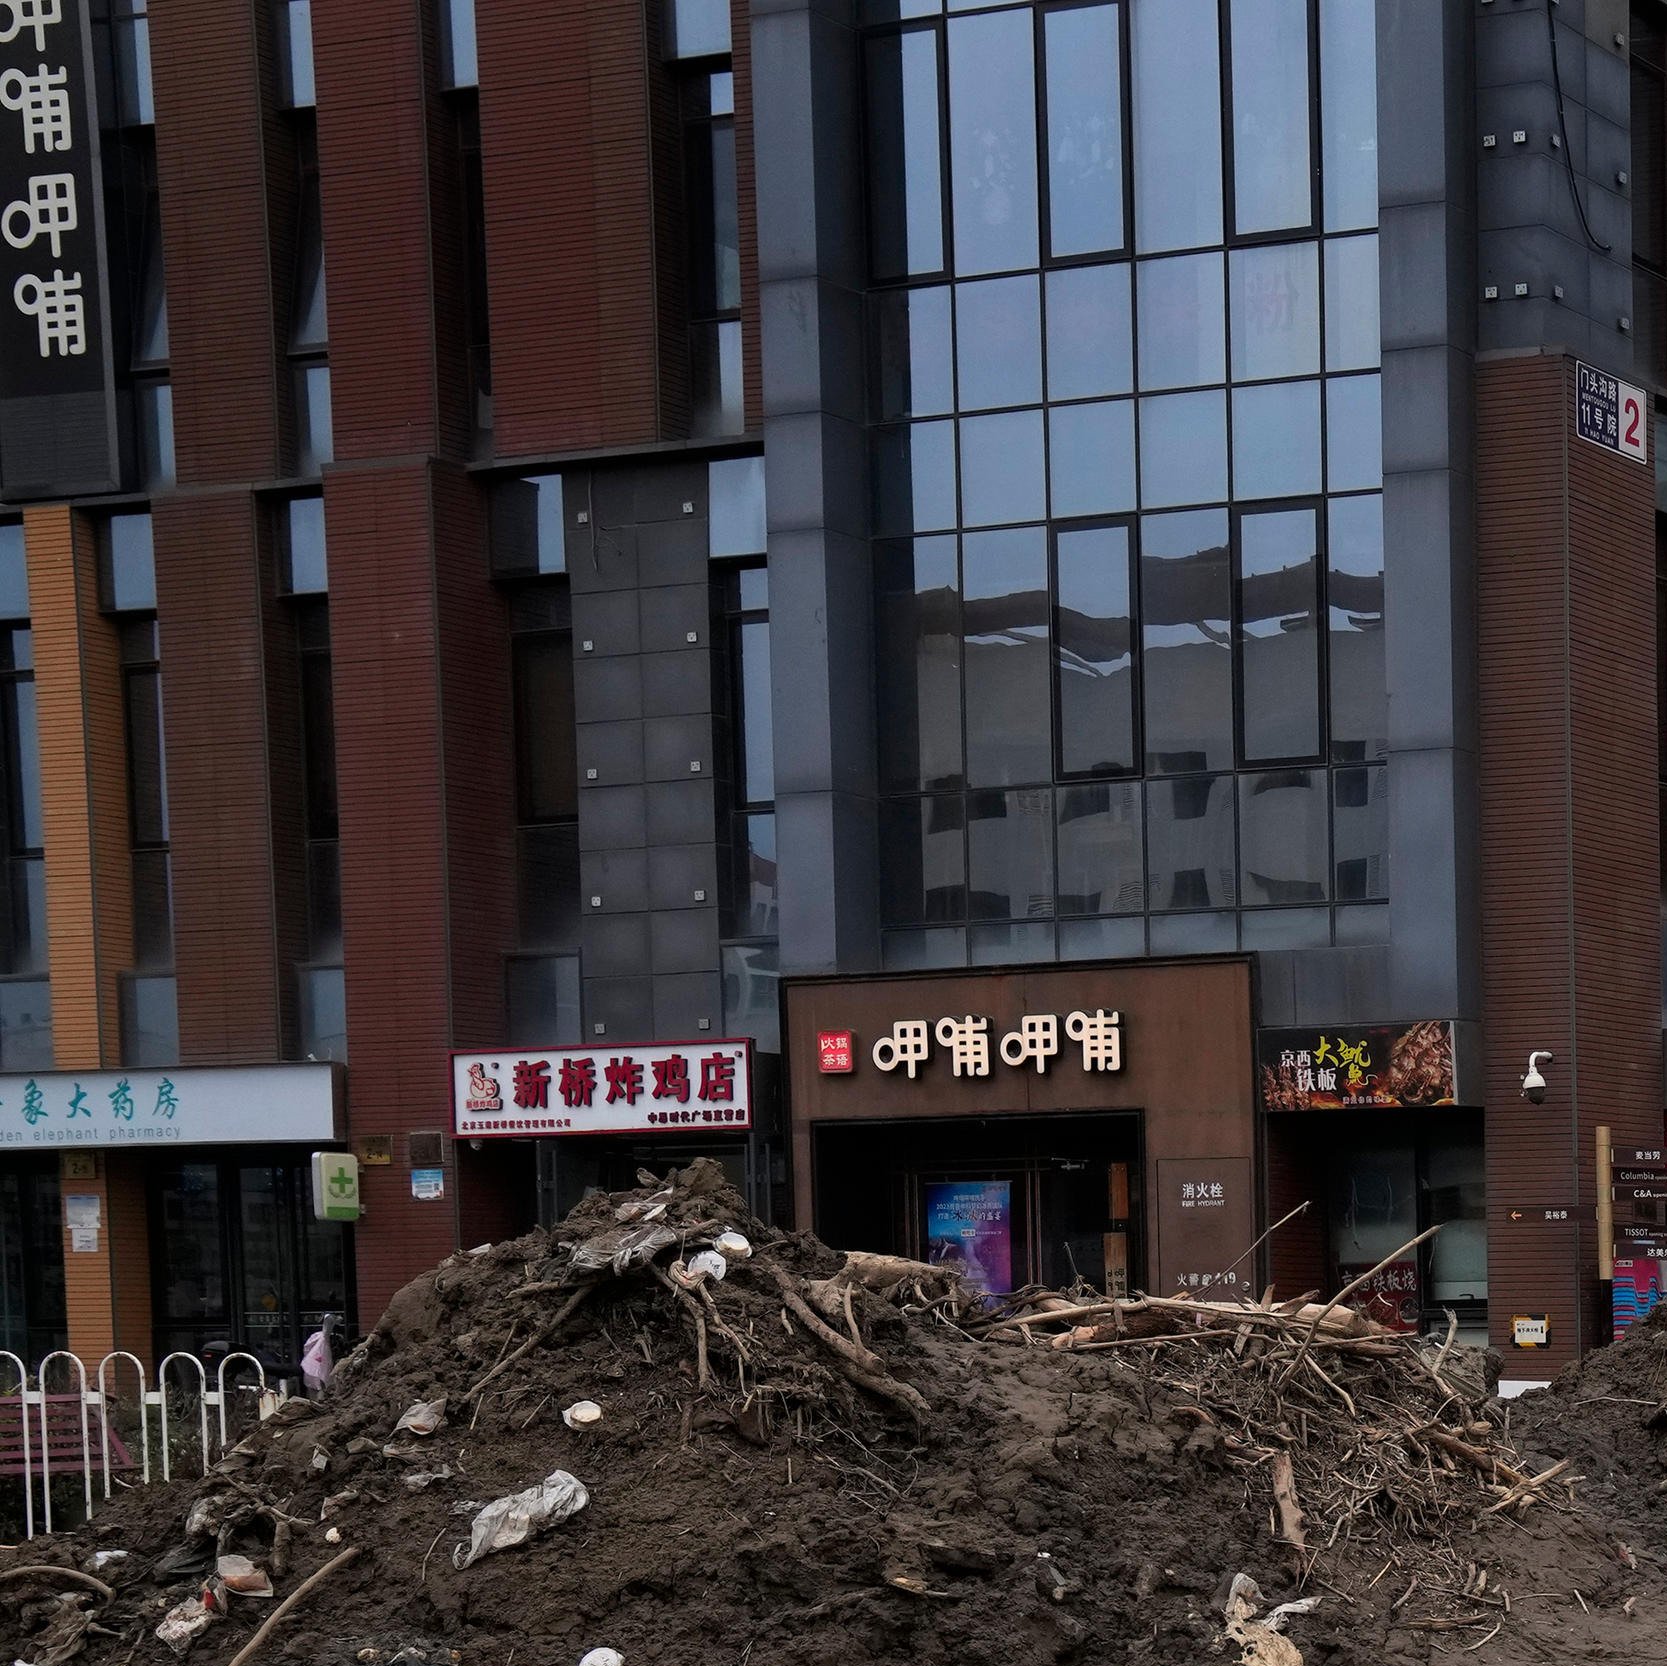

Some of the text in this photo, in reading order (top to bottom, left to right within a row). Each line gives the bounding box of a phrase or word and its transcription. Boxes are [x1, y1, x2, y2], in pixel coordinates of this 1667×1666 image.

[1580, 367, 1617, 402] 门头沟路
[1582, 391, 1609, 410] MENTOUGOU
[1581, 402, 1617, 437] 11号院
[1624, 398, 1640, 448] 2
[872, 1009, 1122, 1079] 呷哺呷哺
[1279, 1050, 1311, 1068] 京西
[512, 1052, 736, 1109] 新桥炸鸡店
[1295, 1067, 1337, 1092] 铁板
[0, 1077, 180, 1126] 象大药房
[33, 1127, 99, 1144] elephant
[109, 1126, 181, 1143] pharmacy
[1635, 1150, 1662, 1161] 麦当劳
[1619, 1171, 1655, 1181] Columbia
[1182, 1182, 1224, 1199] 消火栓
[1633, 1189, 1652, 1198] C&A
[1181, 1200, 1195, 1208] FIRE
[1544, 1209, 1568, 1220] 吴裕泰
[1624, 1227, 1649, 1237] TISSOT
